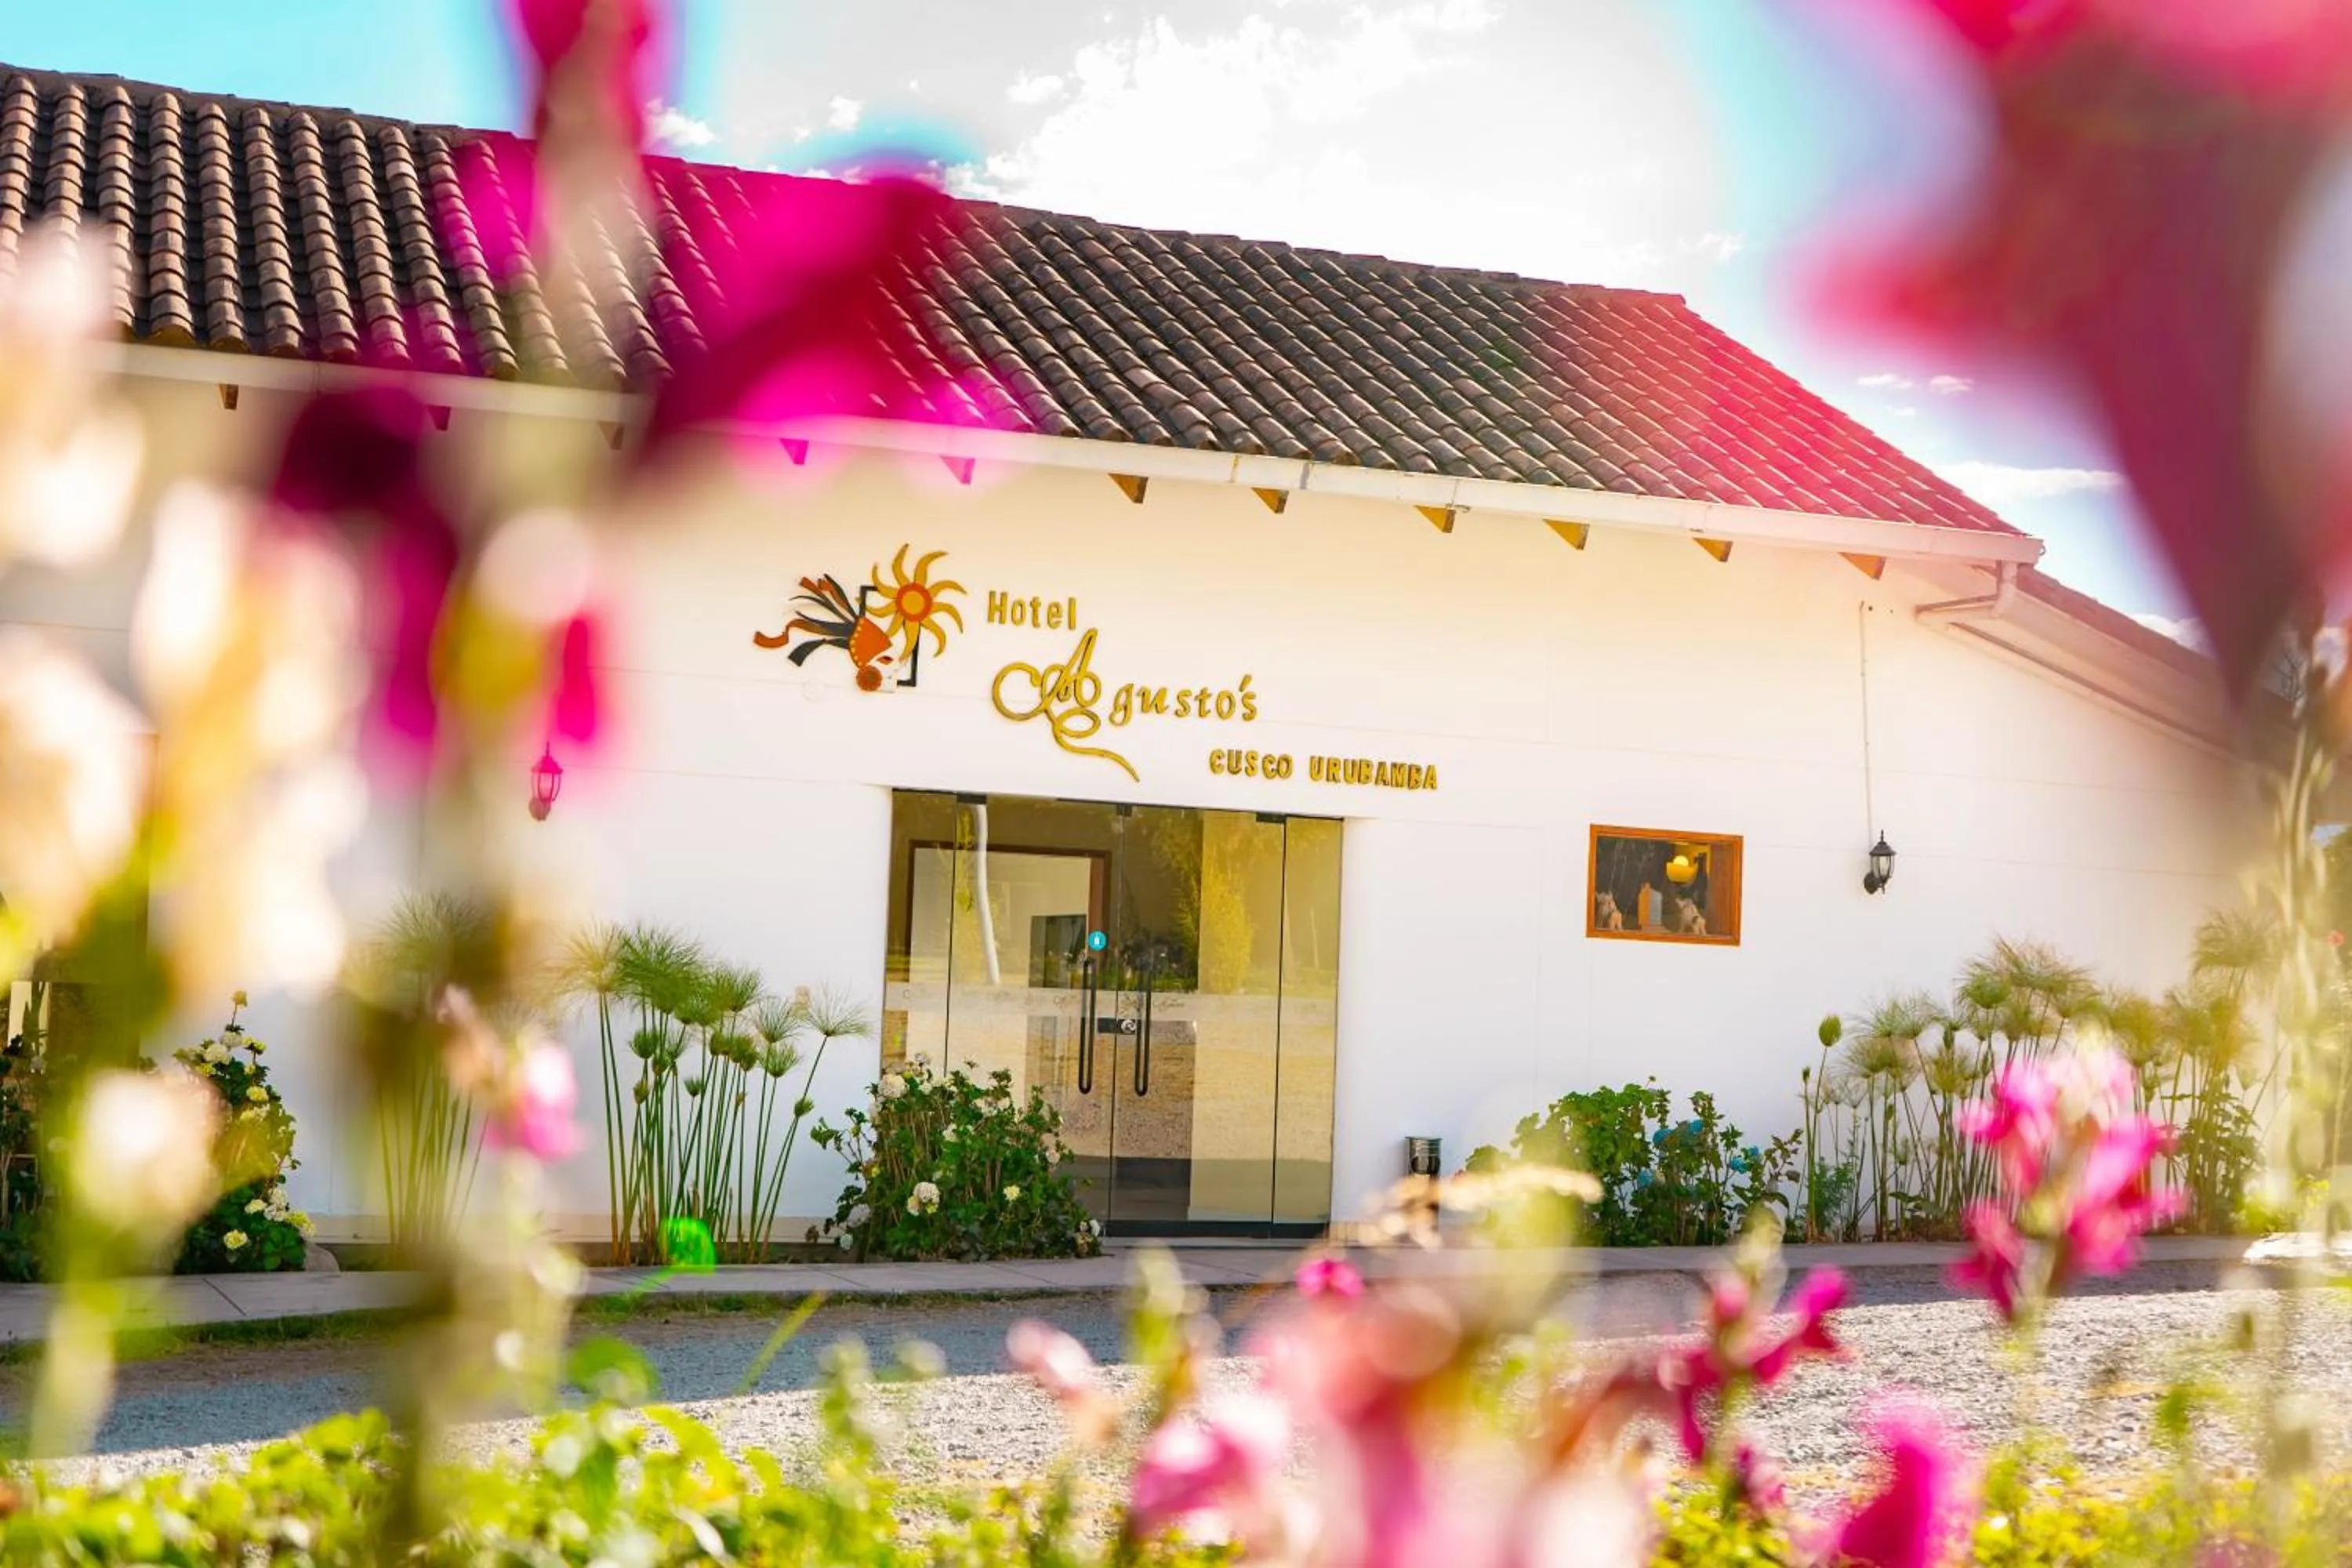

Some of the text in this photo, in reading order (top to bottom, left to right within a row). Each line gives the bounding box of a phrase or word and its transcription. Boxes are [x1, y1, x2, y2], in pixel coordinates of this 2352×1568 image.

[987, 590, 1077, 631] Hotel
[1208, 748, 1438, 790] CUSCO URUBAMBA
